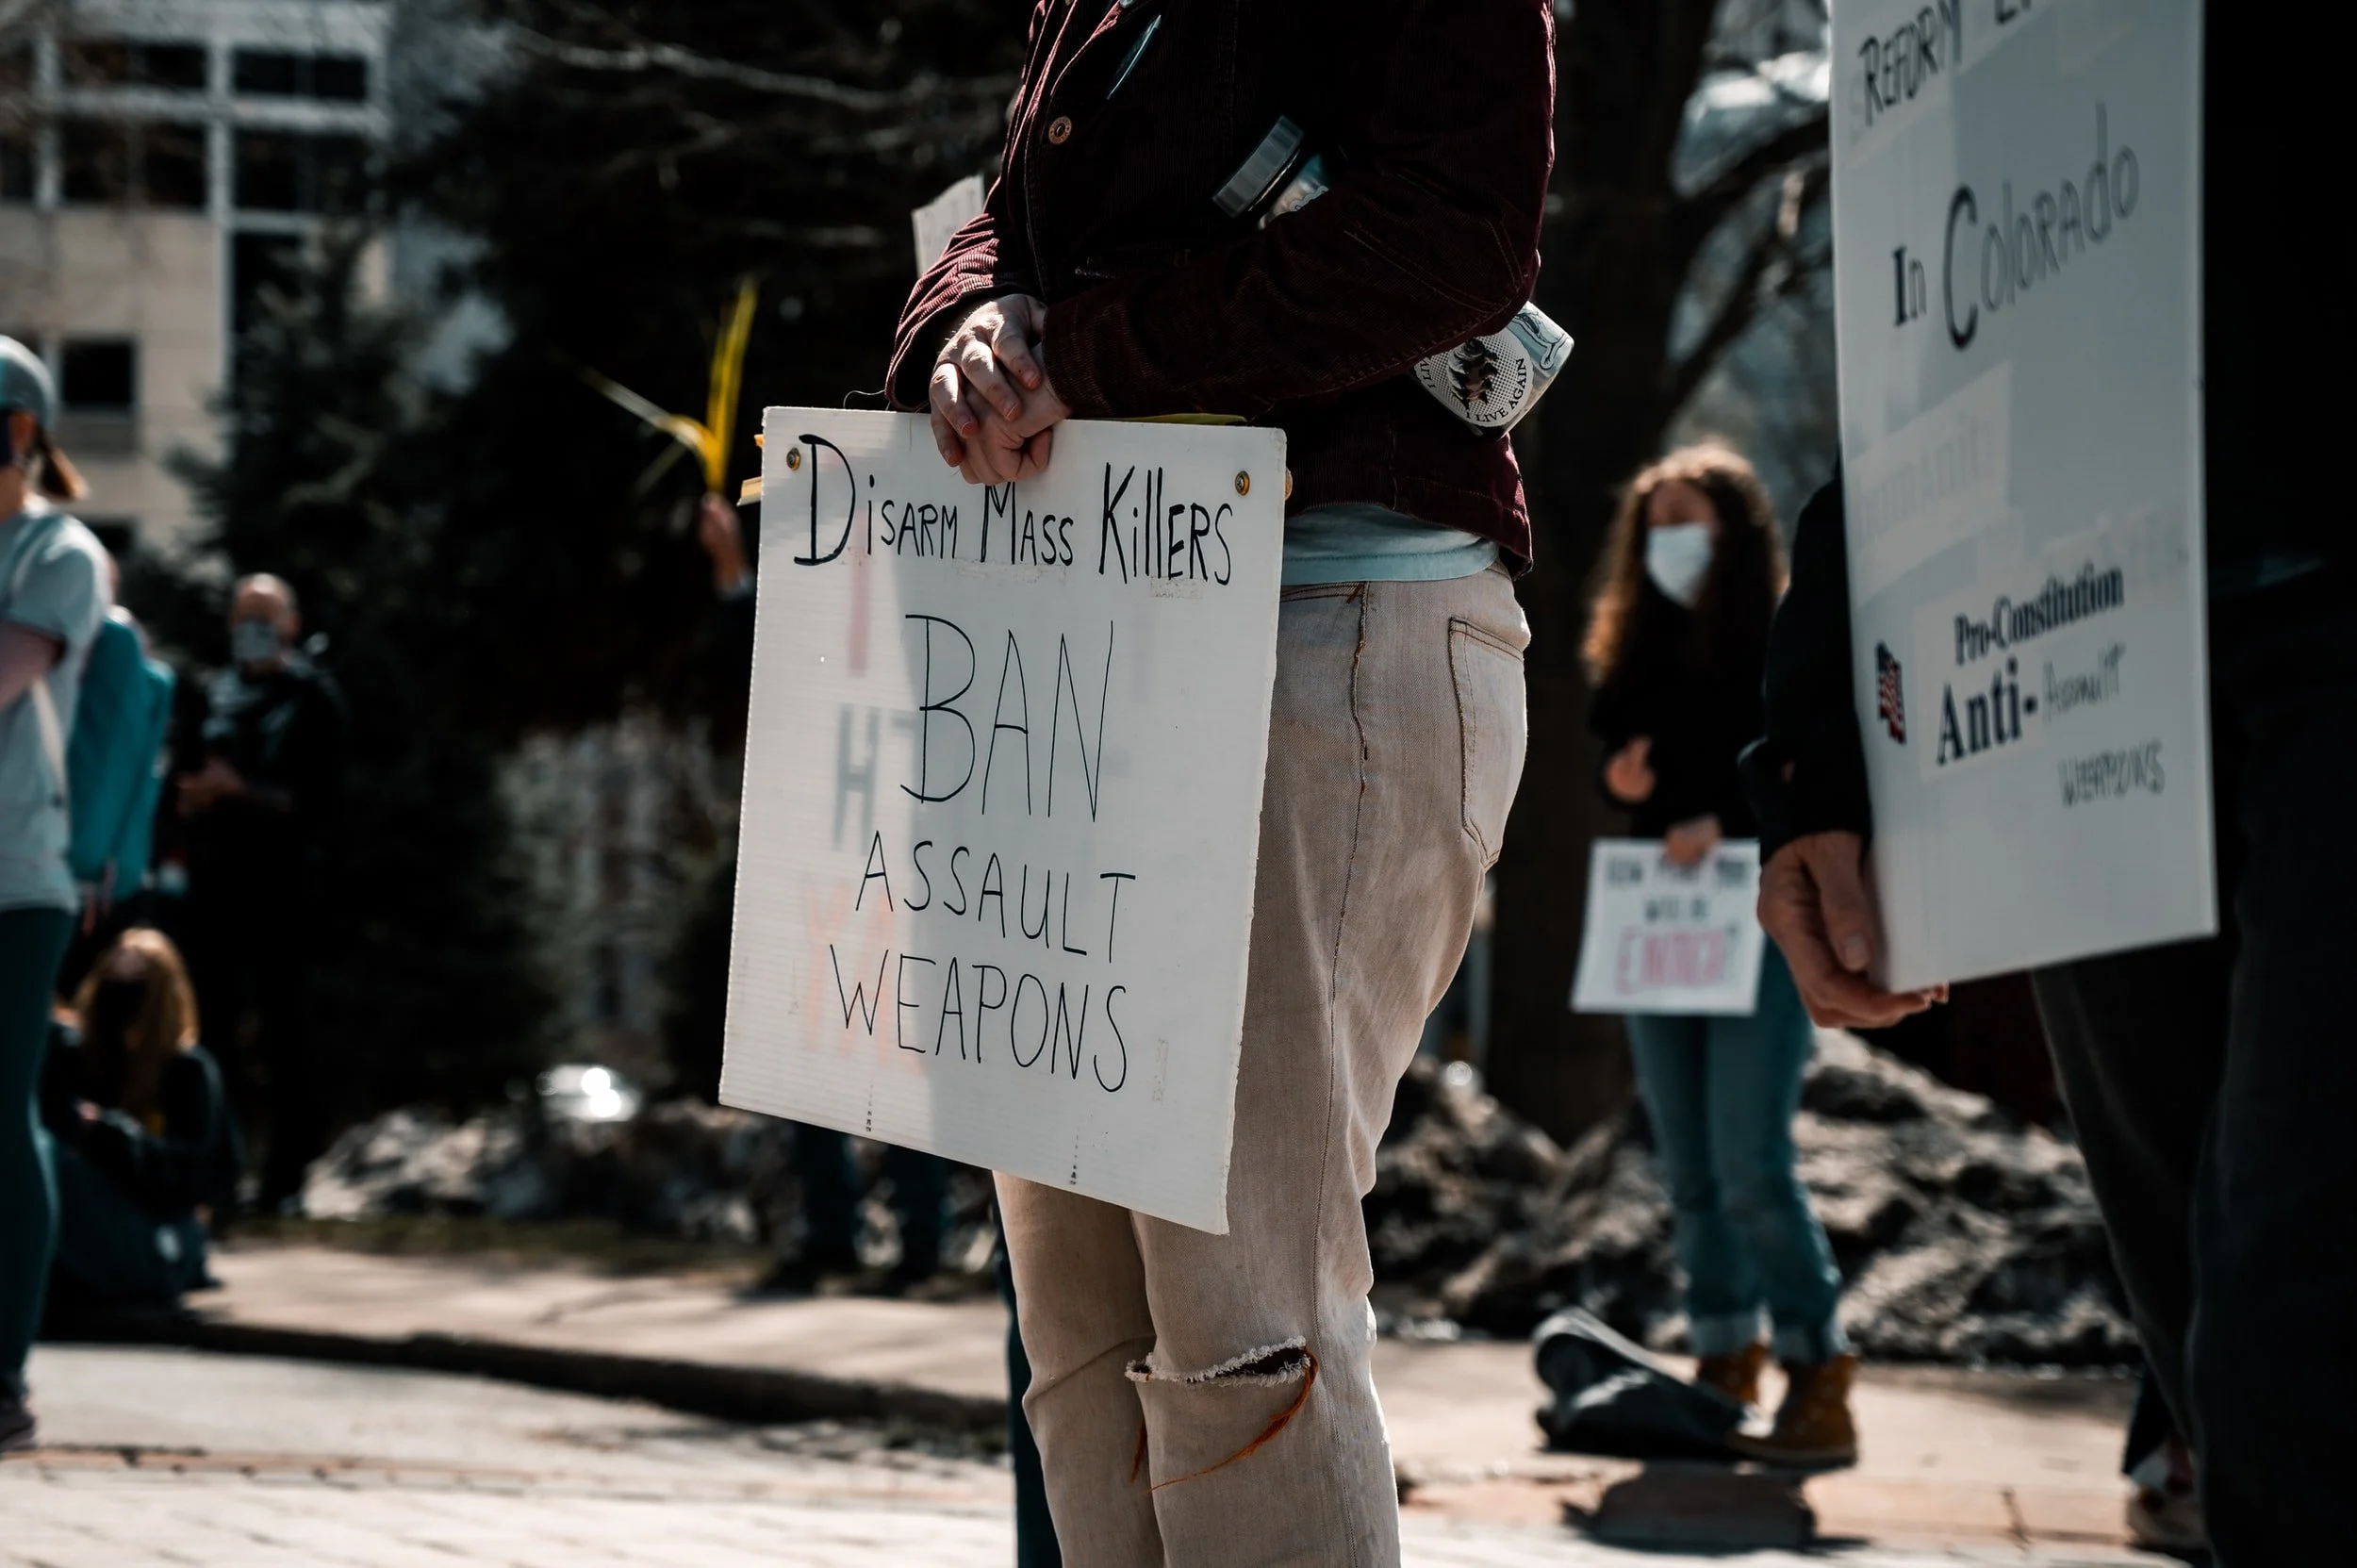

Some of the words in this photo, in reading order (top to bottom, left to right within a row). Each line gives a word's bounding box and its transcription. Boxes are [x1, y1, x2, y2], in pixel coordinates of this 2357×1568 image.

[1893, 245, 1926, 327] In
[1476, 408, 1508, 422] LIVE
[1508, 357, 1527, 410] AGAIN
[1953, 560, 2125, 666] Pro-Constitution
[899, 614, 1114, 823] BAN
[1936, 656, 2038, 767] Anti-
[2057, 738, 2167, 808] WEAPONS
[855, 830, 1137, 964] ASSAULT
[830, 943, 1128, 1094] WEAPONS
